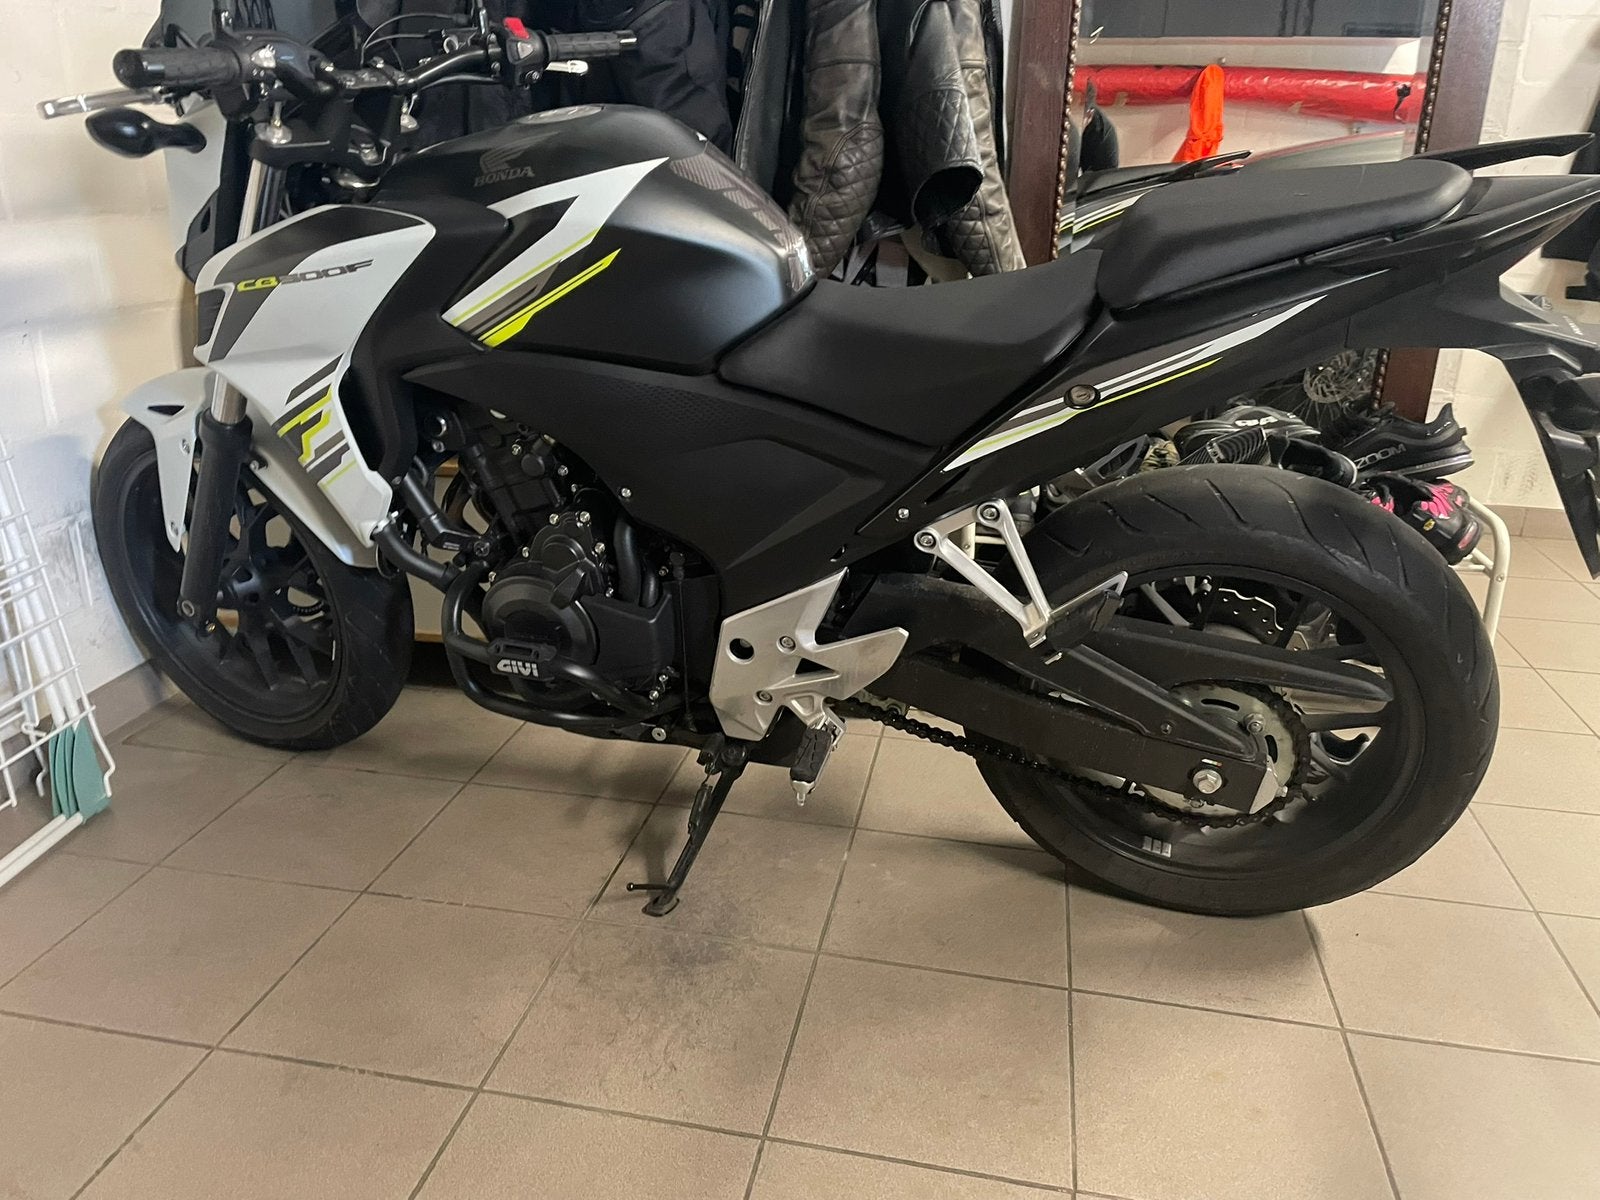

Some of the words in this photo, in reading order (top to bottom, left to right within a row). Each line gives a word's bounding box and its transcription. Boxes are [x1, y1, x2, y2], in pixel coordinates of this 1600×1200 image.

[474, 166, 535, 187] HONDA
[1354, 443, 1407, 470] ZOOM
[496, 658, 539, 678] GIVI
